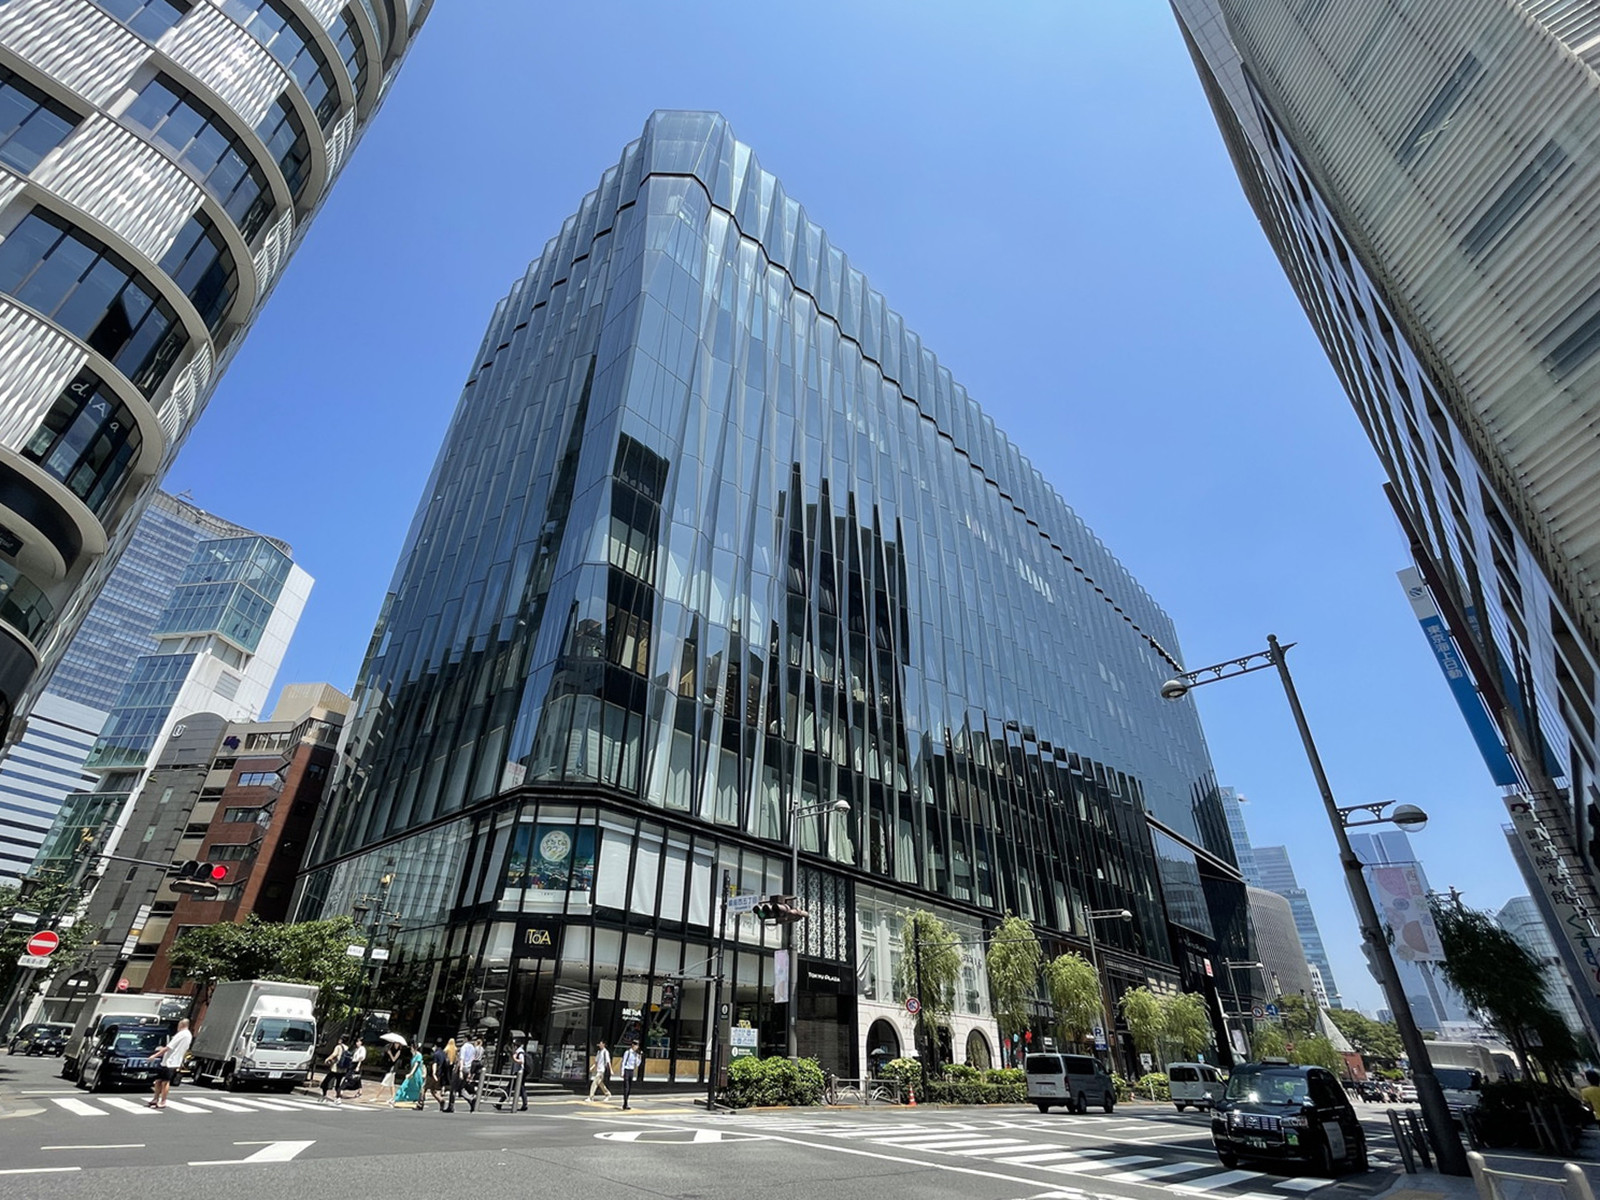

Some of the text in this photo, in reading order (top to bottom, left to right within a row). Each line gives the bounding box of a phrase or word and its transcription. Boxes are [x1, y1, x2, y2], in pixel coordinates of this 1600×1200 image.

[1427, 624, 1463, 680] 東京海上日動
[1517, 790, 1589, 920] VINTAGE
